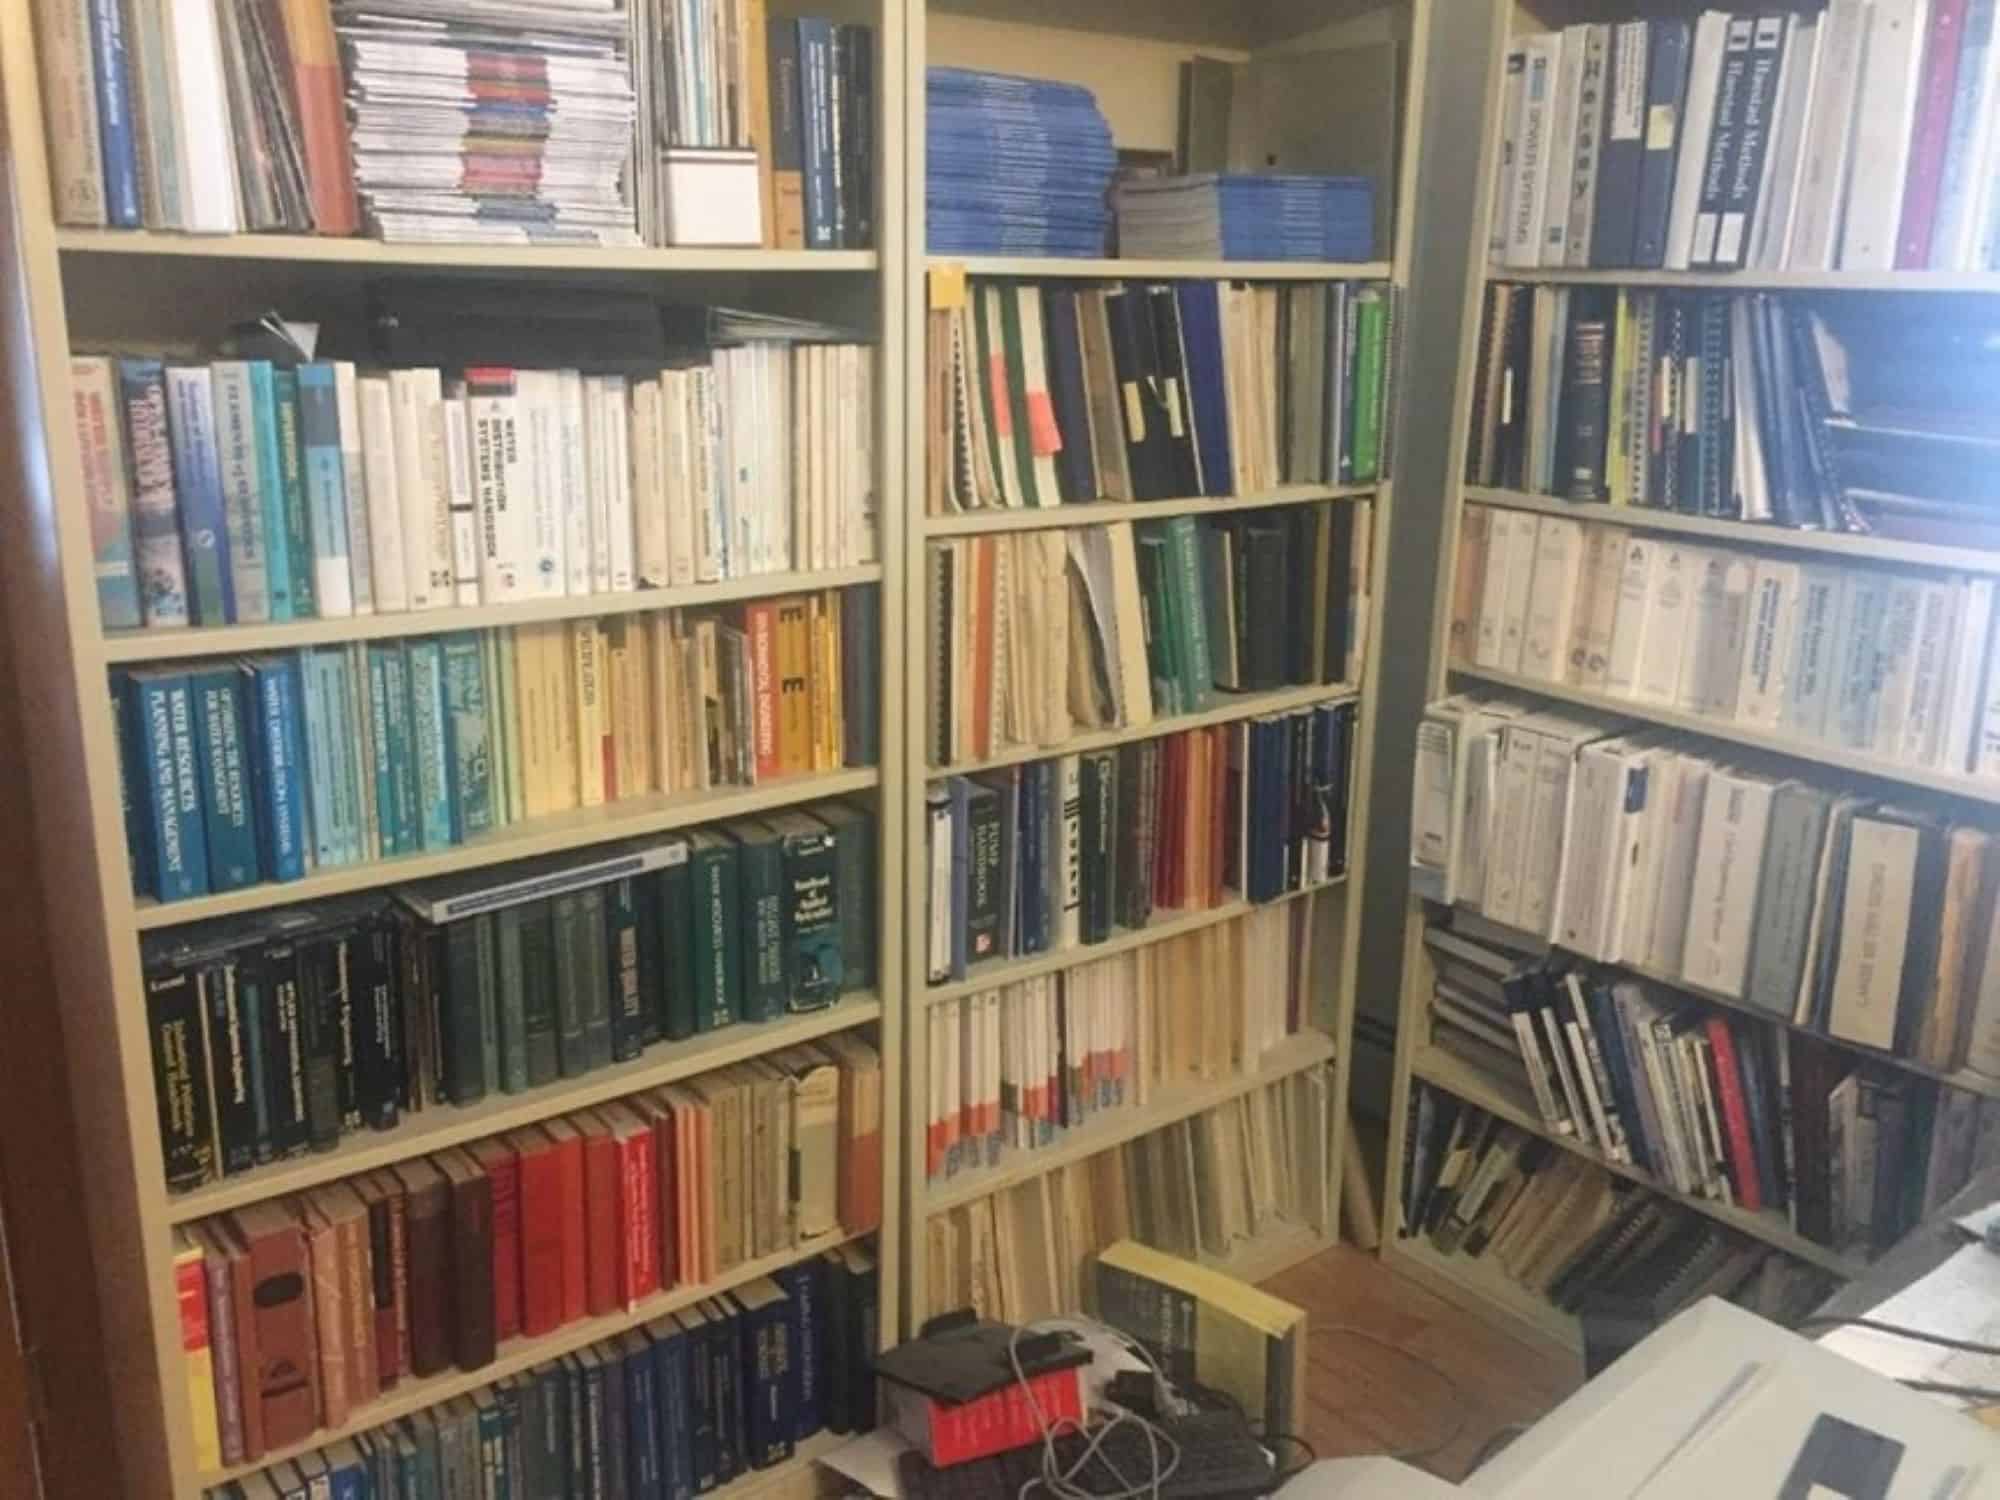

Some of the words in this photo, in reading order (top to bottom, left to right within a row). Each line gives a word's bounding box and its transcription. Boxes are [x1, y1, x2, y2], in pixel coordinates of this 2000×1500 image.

[1731, 129, 1759, 200] Methods
[478, 419, 492, 481] SYSTEMS
[491, 418, 507, 512] DISTRIBUTION
[504, 418, 517, 463] WATER
[481, 487, 497, 559] HANDBOOK
[150, 691, 168, 756] PLANNING
[171, 689, 188, 734] WATER
[158, 758, 172, 785] AND
[176, 736, 195, 812] RESOURCES
[210, 747, 228, 815] MANAGEMENT
[227, 771, 245, 827] RESOURCES
[159, 788, 181, 872] MANAGEMENT
[975, 825, 987, 908] HANDBOOK
